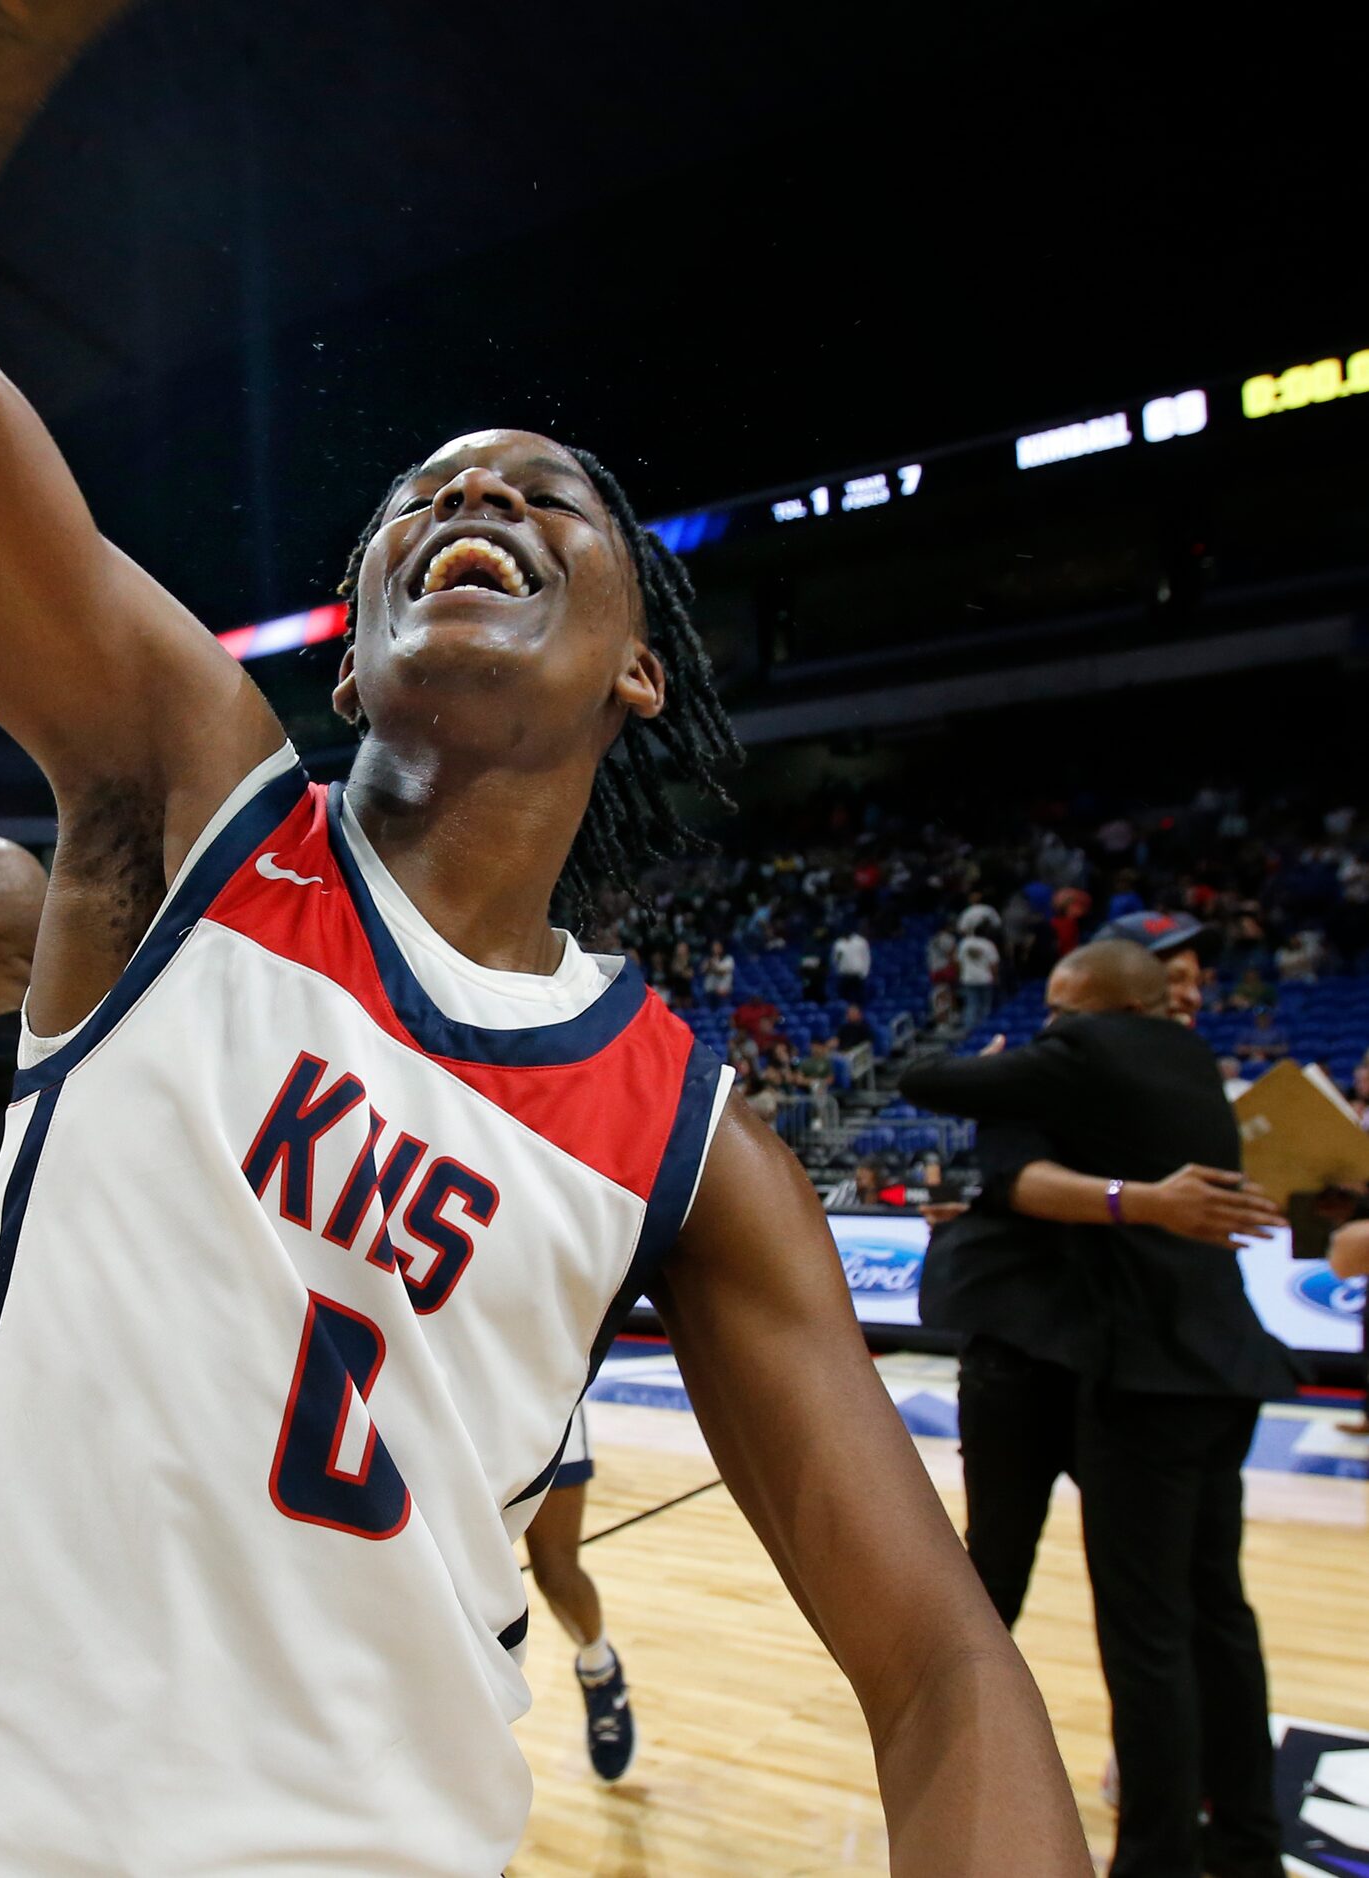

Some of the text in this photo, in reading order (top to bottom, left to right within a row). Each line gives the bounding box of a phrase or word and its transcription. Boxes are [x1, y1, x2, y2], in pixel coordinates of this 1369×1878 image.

[897, 463, 922, 496] 7
[809, 486, 829, 516] 1
[242, 1050, 501, 1315] KHS
